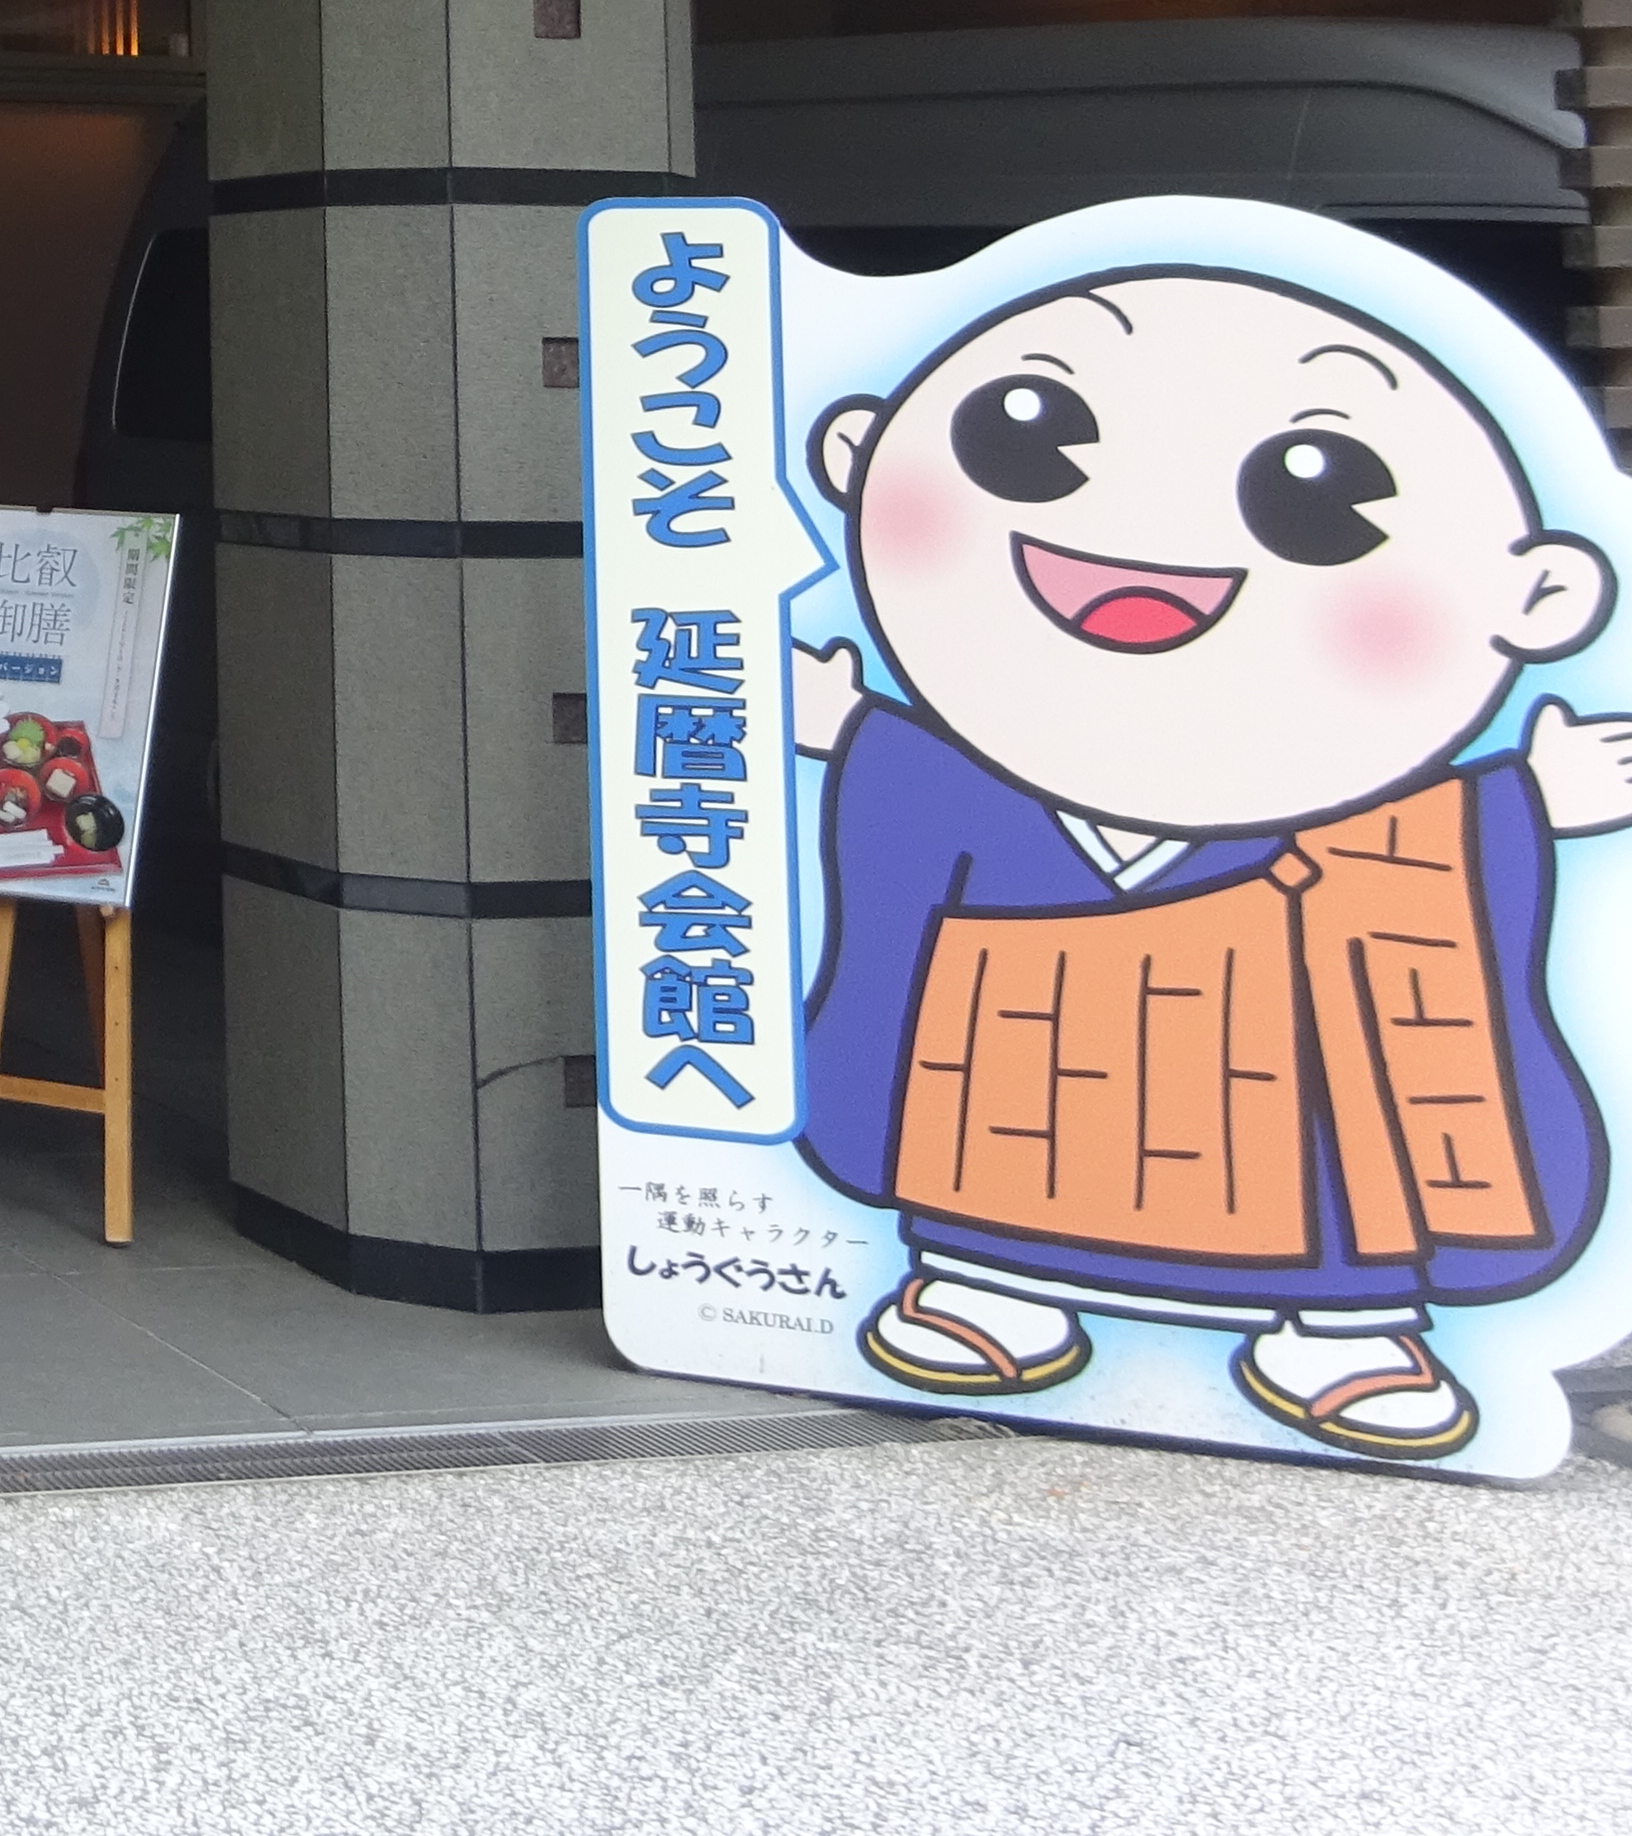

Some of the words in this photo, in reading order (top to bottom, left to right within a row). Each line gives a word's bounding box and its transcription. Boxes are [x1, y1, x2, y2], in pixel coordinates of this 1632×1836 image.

[630, 231, 735, 549] ようこそ
[630, 607, 755, 1112] 延暦寺会館へ
[618, 1180, 774, 1214] 一隅を照らす
[656, 1210, 870, 1248] 運動キャラクター
[626, 1244, 848, 1300] しょうぐうさん
